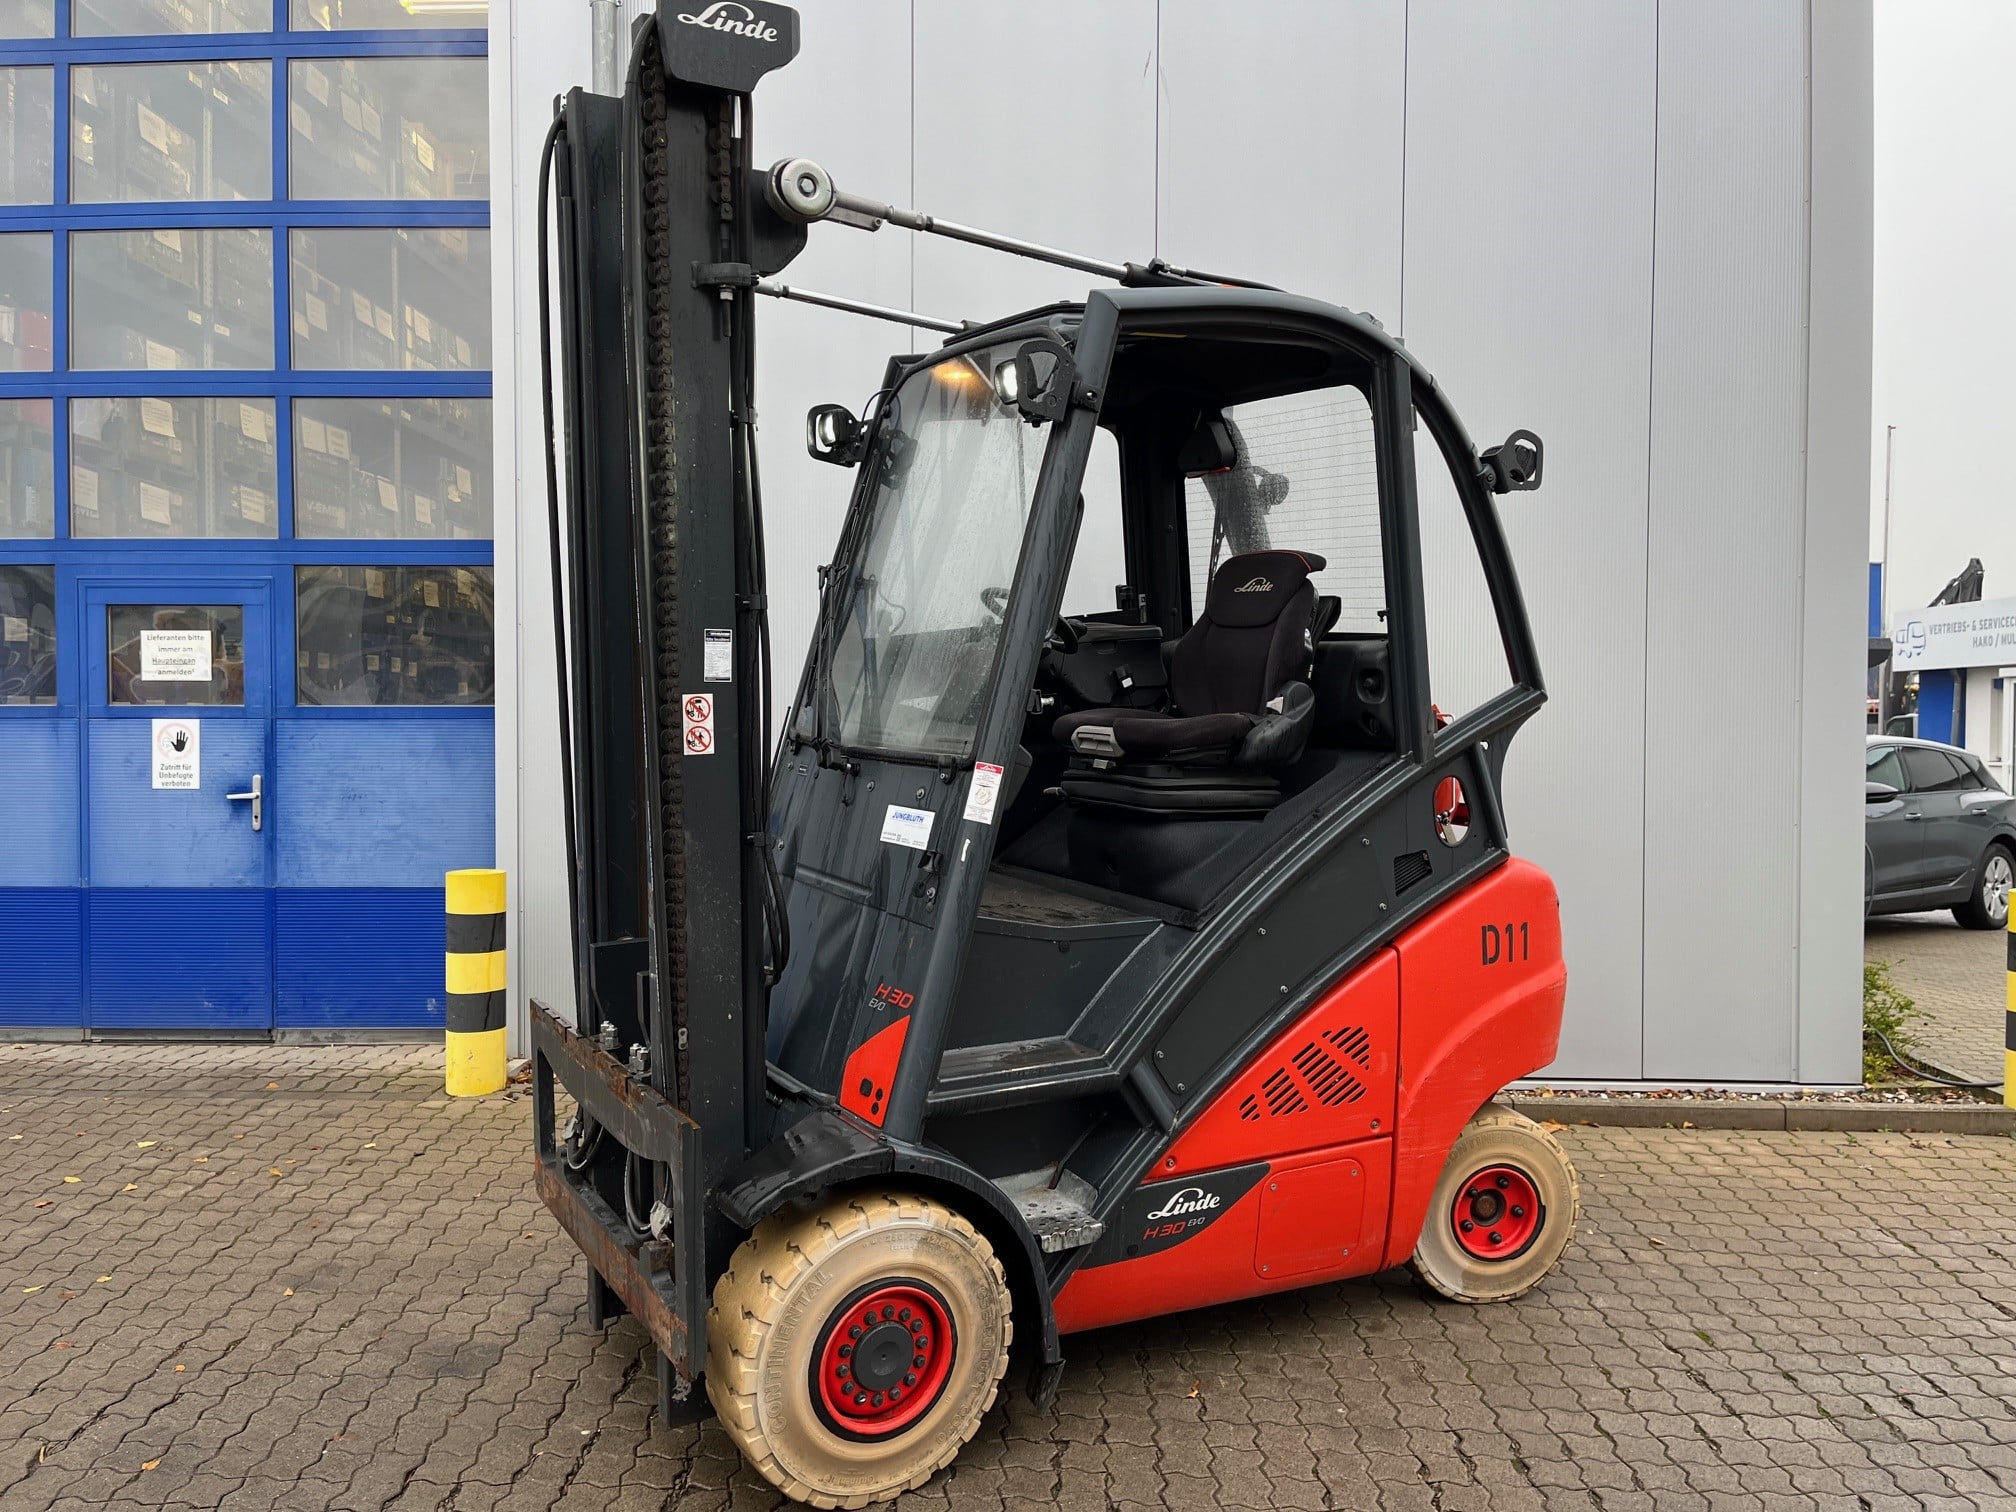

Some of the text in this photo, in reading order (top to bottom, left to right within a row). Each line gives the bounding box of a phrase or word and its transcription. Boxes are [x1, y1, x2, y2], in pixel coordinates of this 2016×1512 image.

[677, 1, 778, 42] Linde
[1233, 576, 1274, 593] Linde
[1929, 621, 1970, 635] VERTRIEBS-
[1979, 616, 2016, 630] SERVICEC
[1972, 635, 1994, 648] HAKO
[892, 812, 925, 823] JUNGBLUTH
[1481, 921, 1529, 966] D11
[868, 997, 886, 1011] EVO
[1146, 1187, 1221, 1220] Linde
[1187, 1217, 1206, 1227] EVO
[765, 1268, 834, 1435] CONTINENTAL
